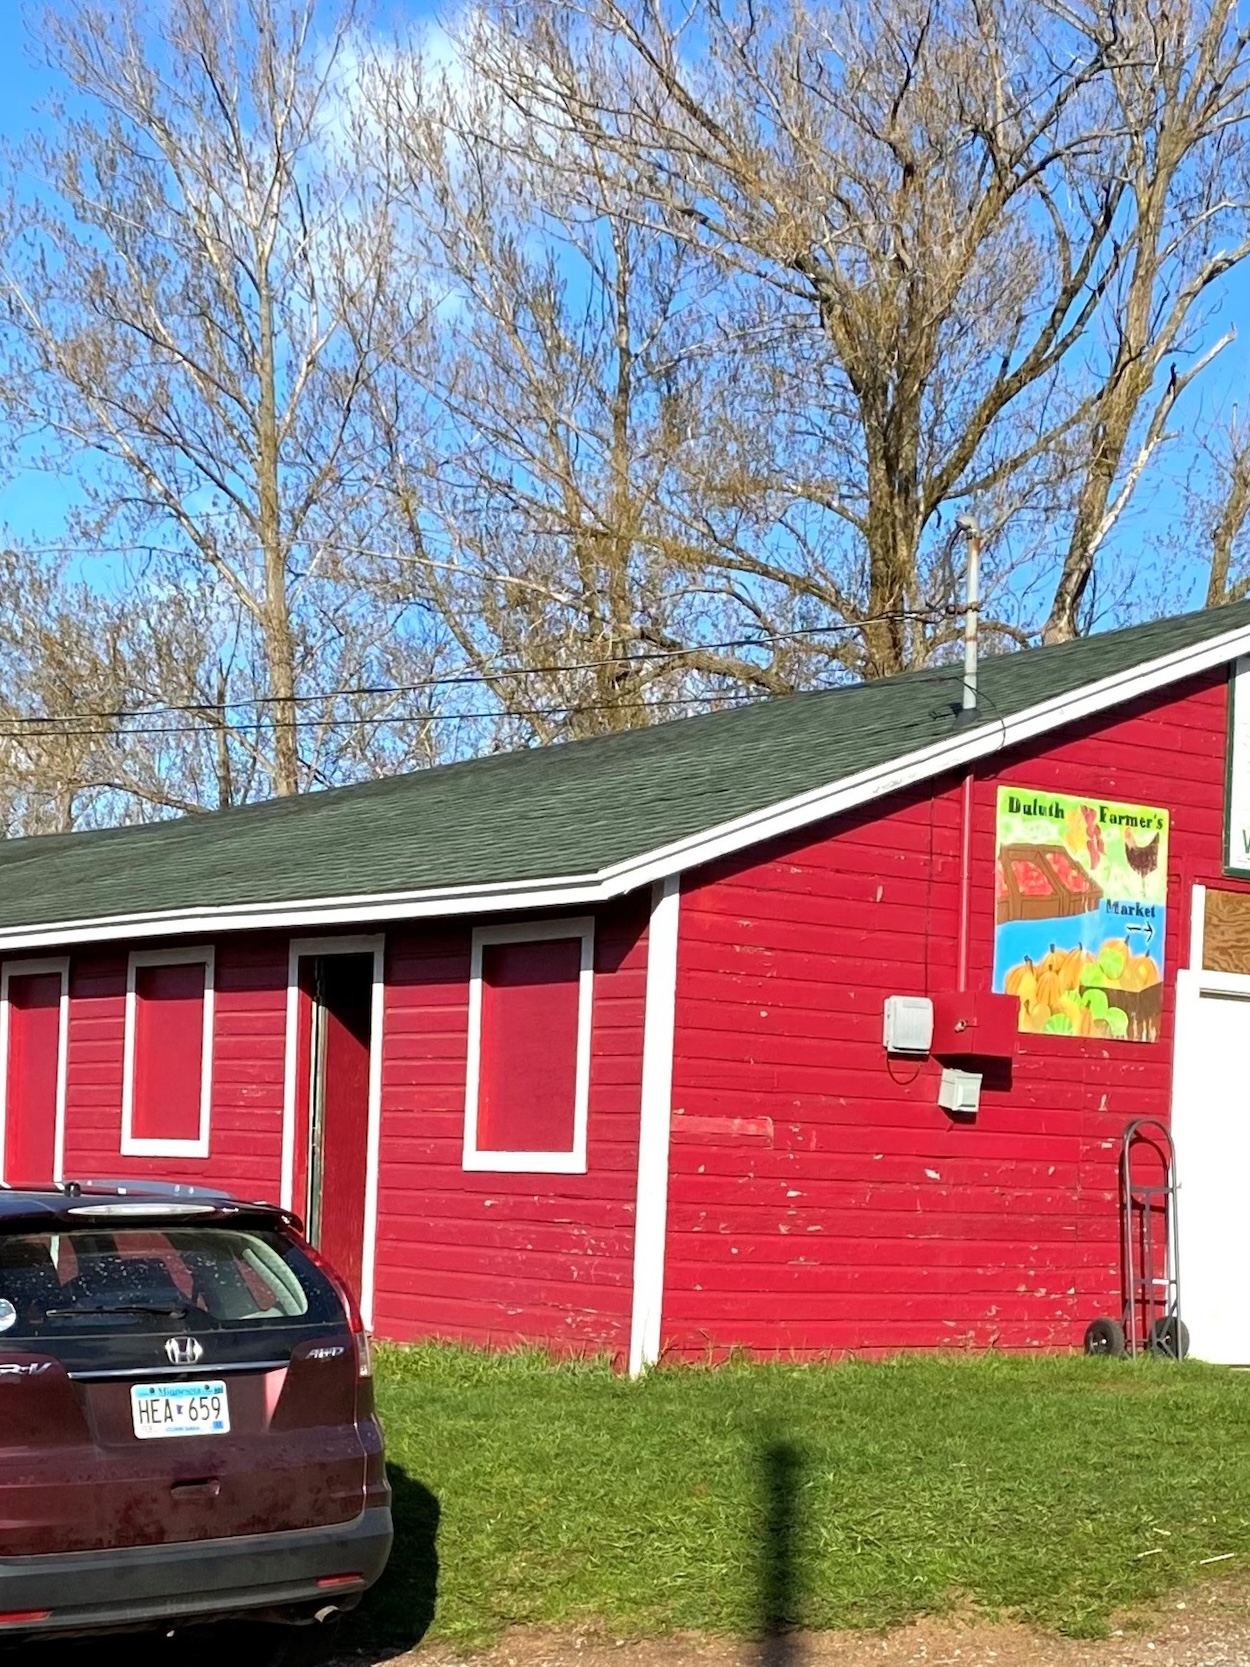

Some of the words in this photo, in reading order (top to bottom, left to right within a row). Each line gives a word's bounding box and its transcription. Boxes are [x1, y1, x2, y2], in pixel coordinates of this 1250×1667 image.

[1008, 796, 1065, 819] Duluth
[1099, 805, 1164, 830] Farmer's
[1106, 898, 1156, 918] Market
[138, 1398, 174, 1424] HEA
[188, 1396, 221, 1422] 659
